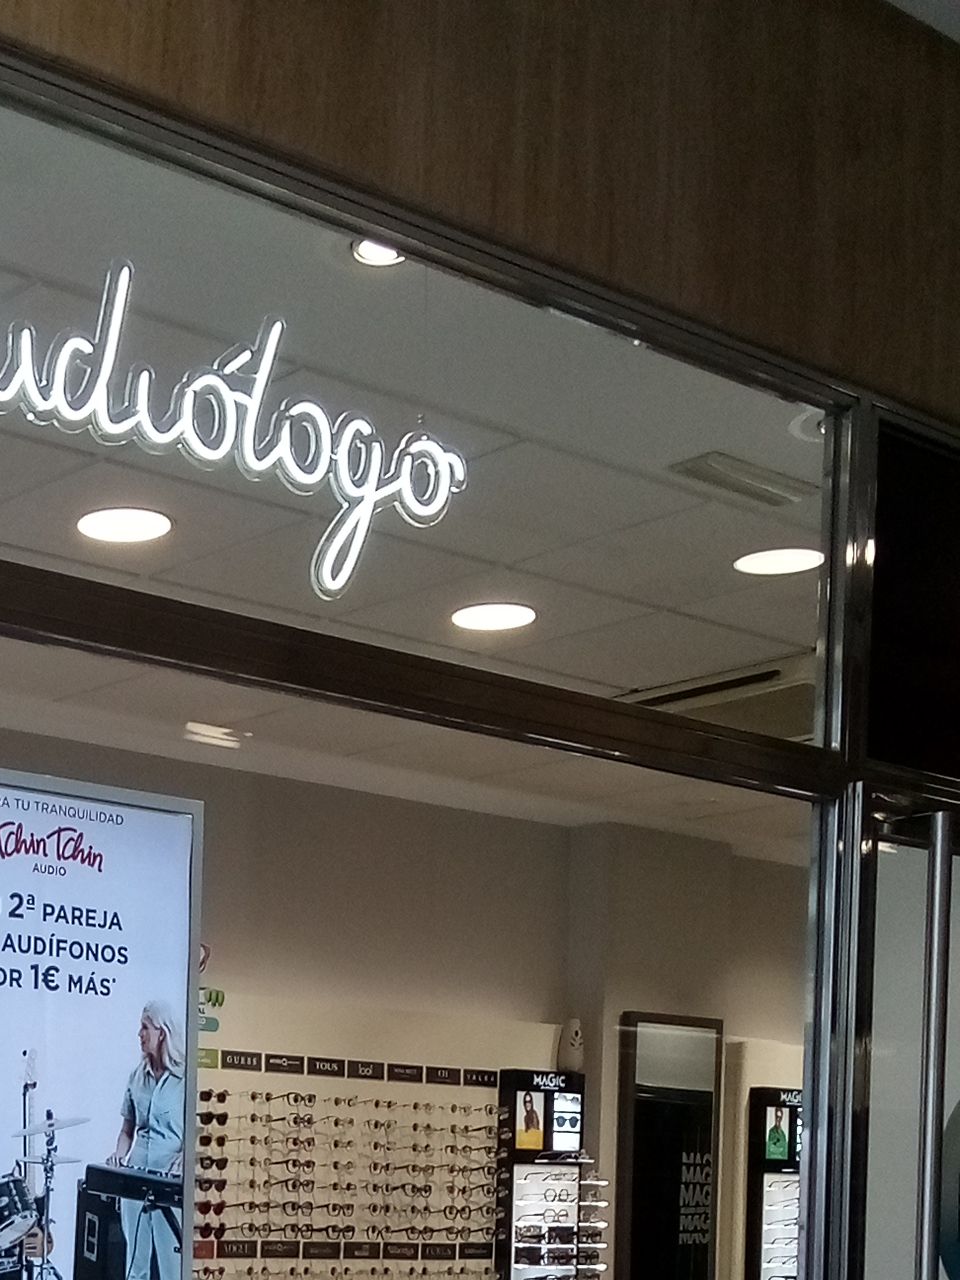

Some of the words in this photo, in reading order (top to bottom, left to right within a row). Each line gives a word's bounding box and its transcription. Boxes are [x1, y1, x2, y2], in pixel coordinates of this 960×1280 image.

[14, 798, 30, 812] TU
[34, 800, 124, 826] TRANQUILIDAD
[46, 826, 104, 873] Tchin
[32, 863, 67, 877] AUDIO
[8, 891, 36, 919] 2ª
[42, 903, 123, 931] PAREJA
[2, 932, 129, 965] AUDÍFONOS
[30, 963, 60, 991] 1€
[315, 1061, 339, 1072] TOUS
[533, 1073, 566, 1088] MAGIC
